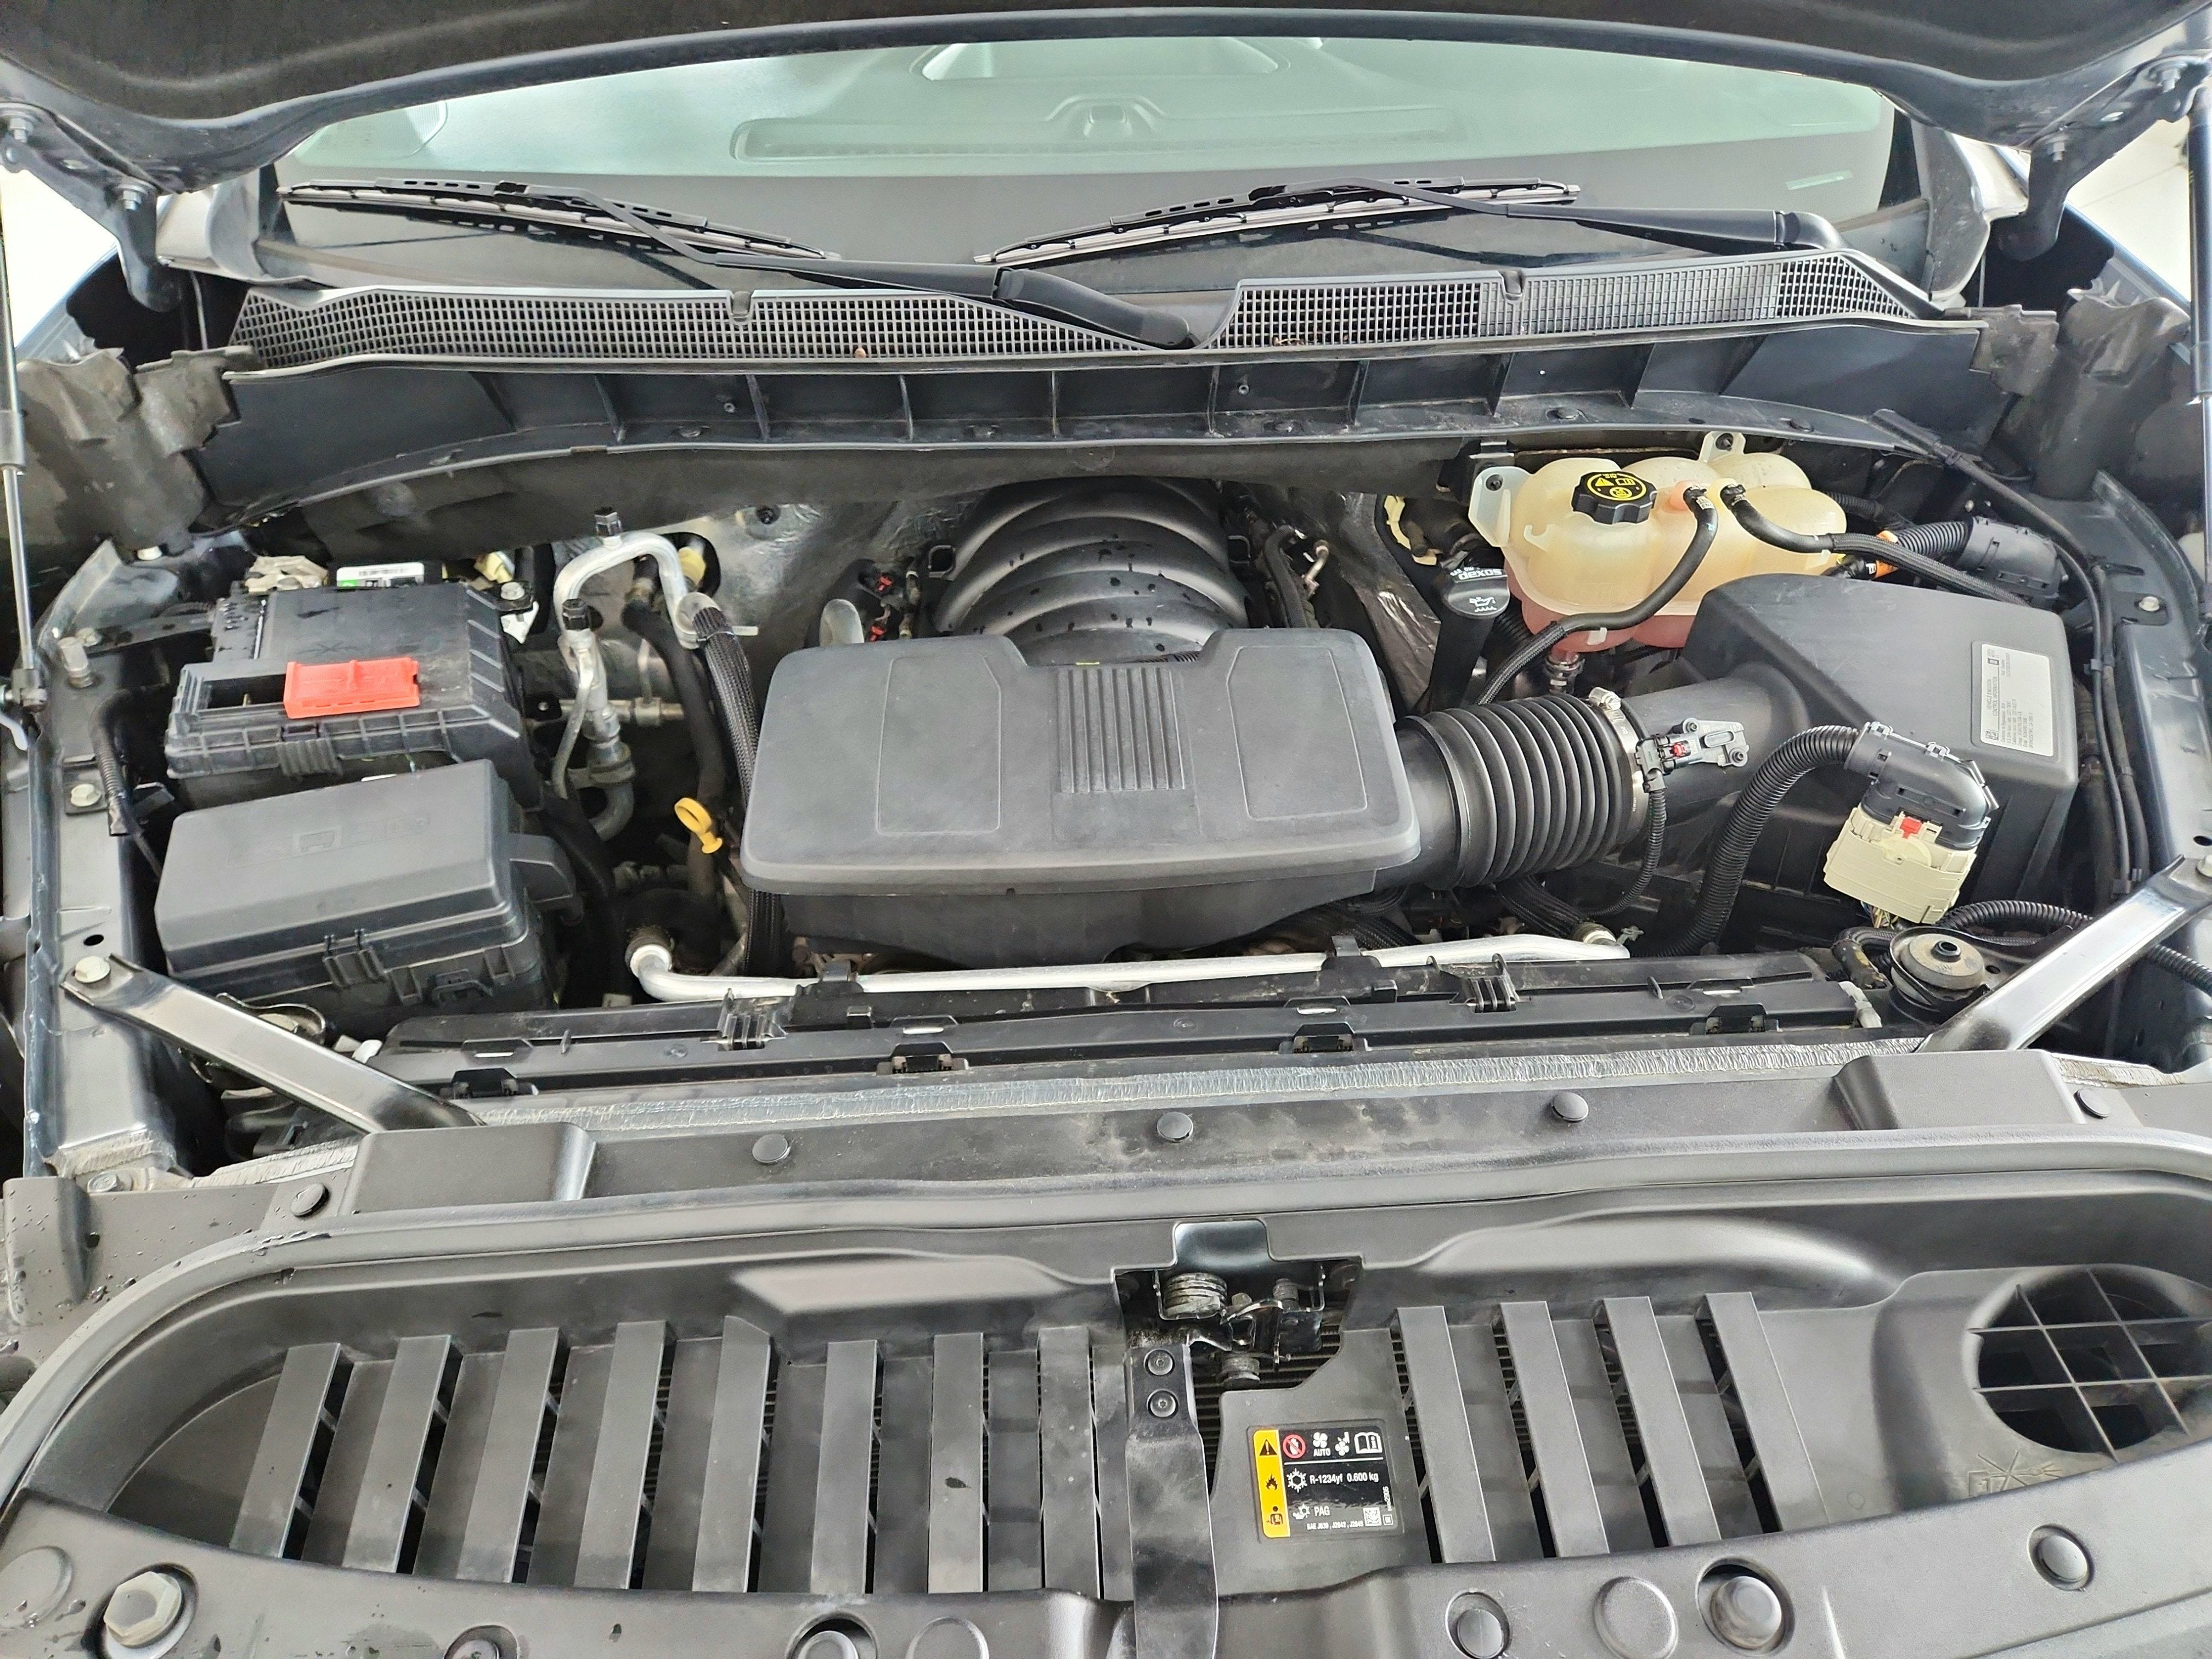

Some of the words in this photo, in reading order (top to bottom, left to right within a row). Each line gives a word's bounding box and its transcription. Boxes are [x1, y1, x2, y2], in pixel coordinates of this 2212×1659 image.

[1458, 569, 1503, 580] dexos
[1313, 1448, 1331, 1457] AUTO
[1310, 1473, 1343, 1485] R-1234yf
[1346, 1471, 1368, 1482] 0.600
[1368, 1471, 1379, 1482] kg
[1314, 1505, 1330, 1516] PAG
